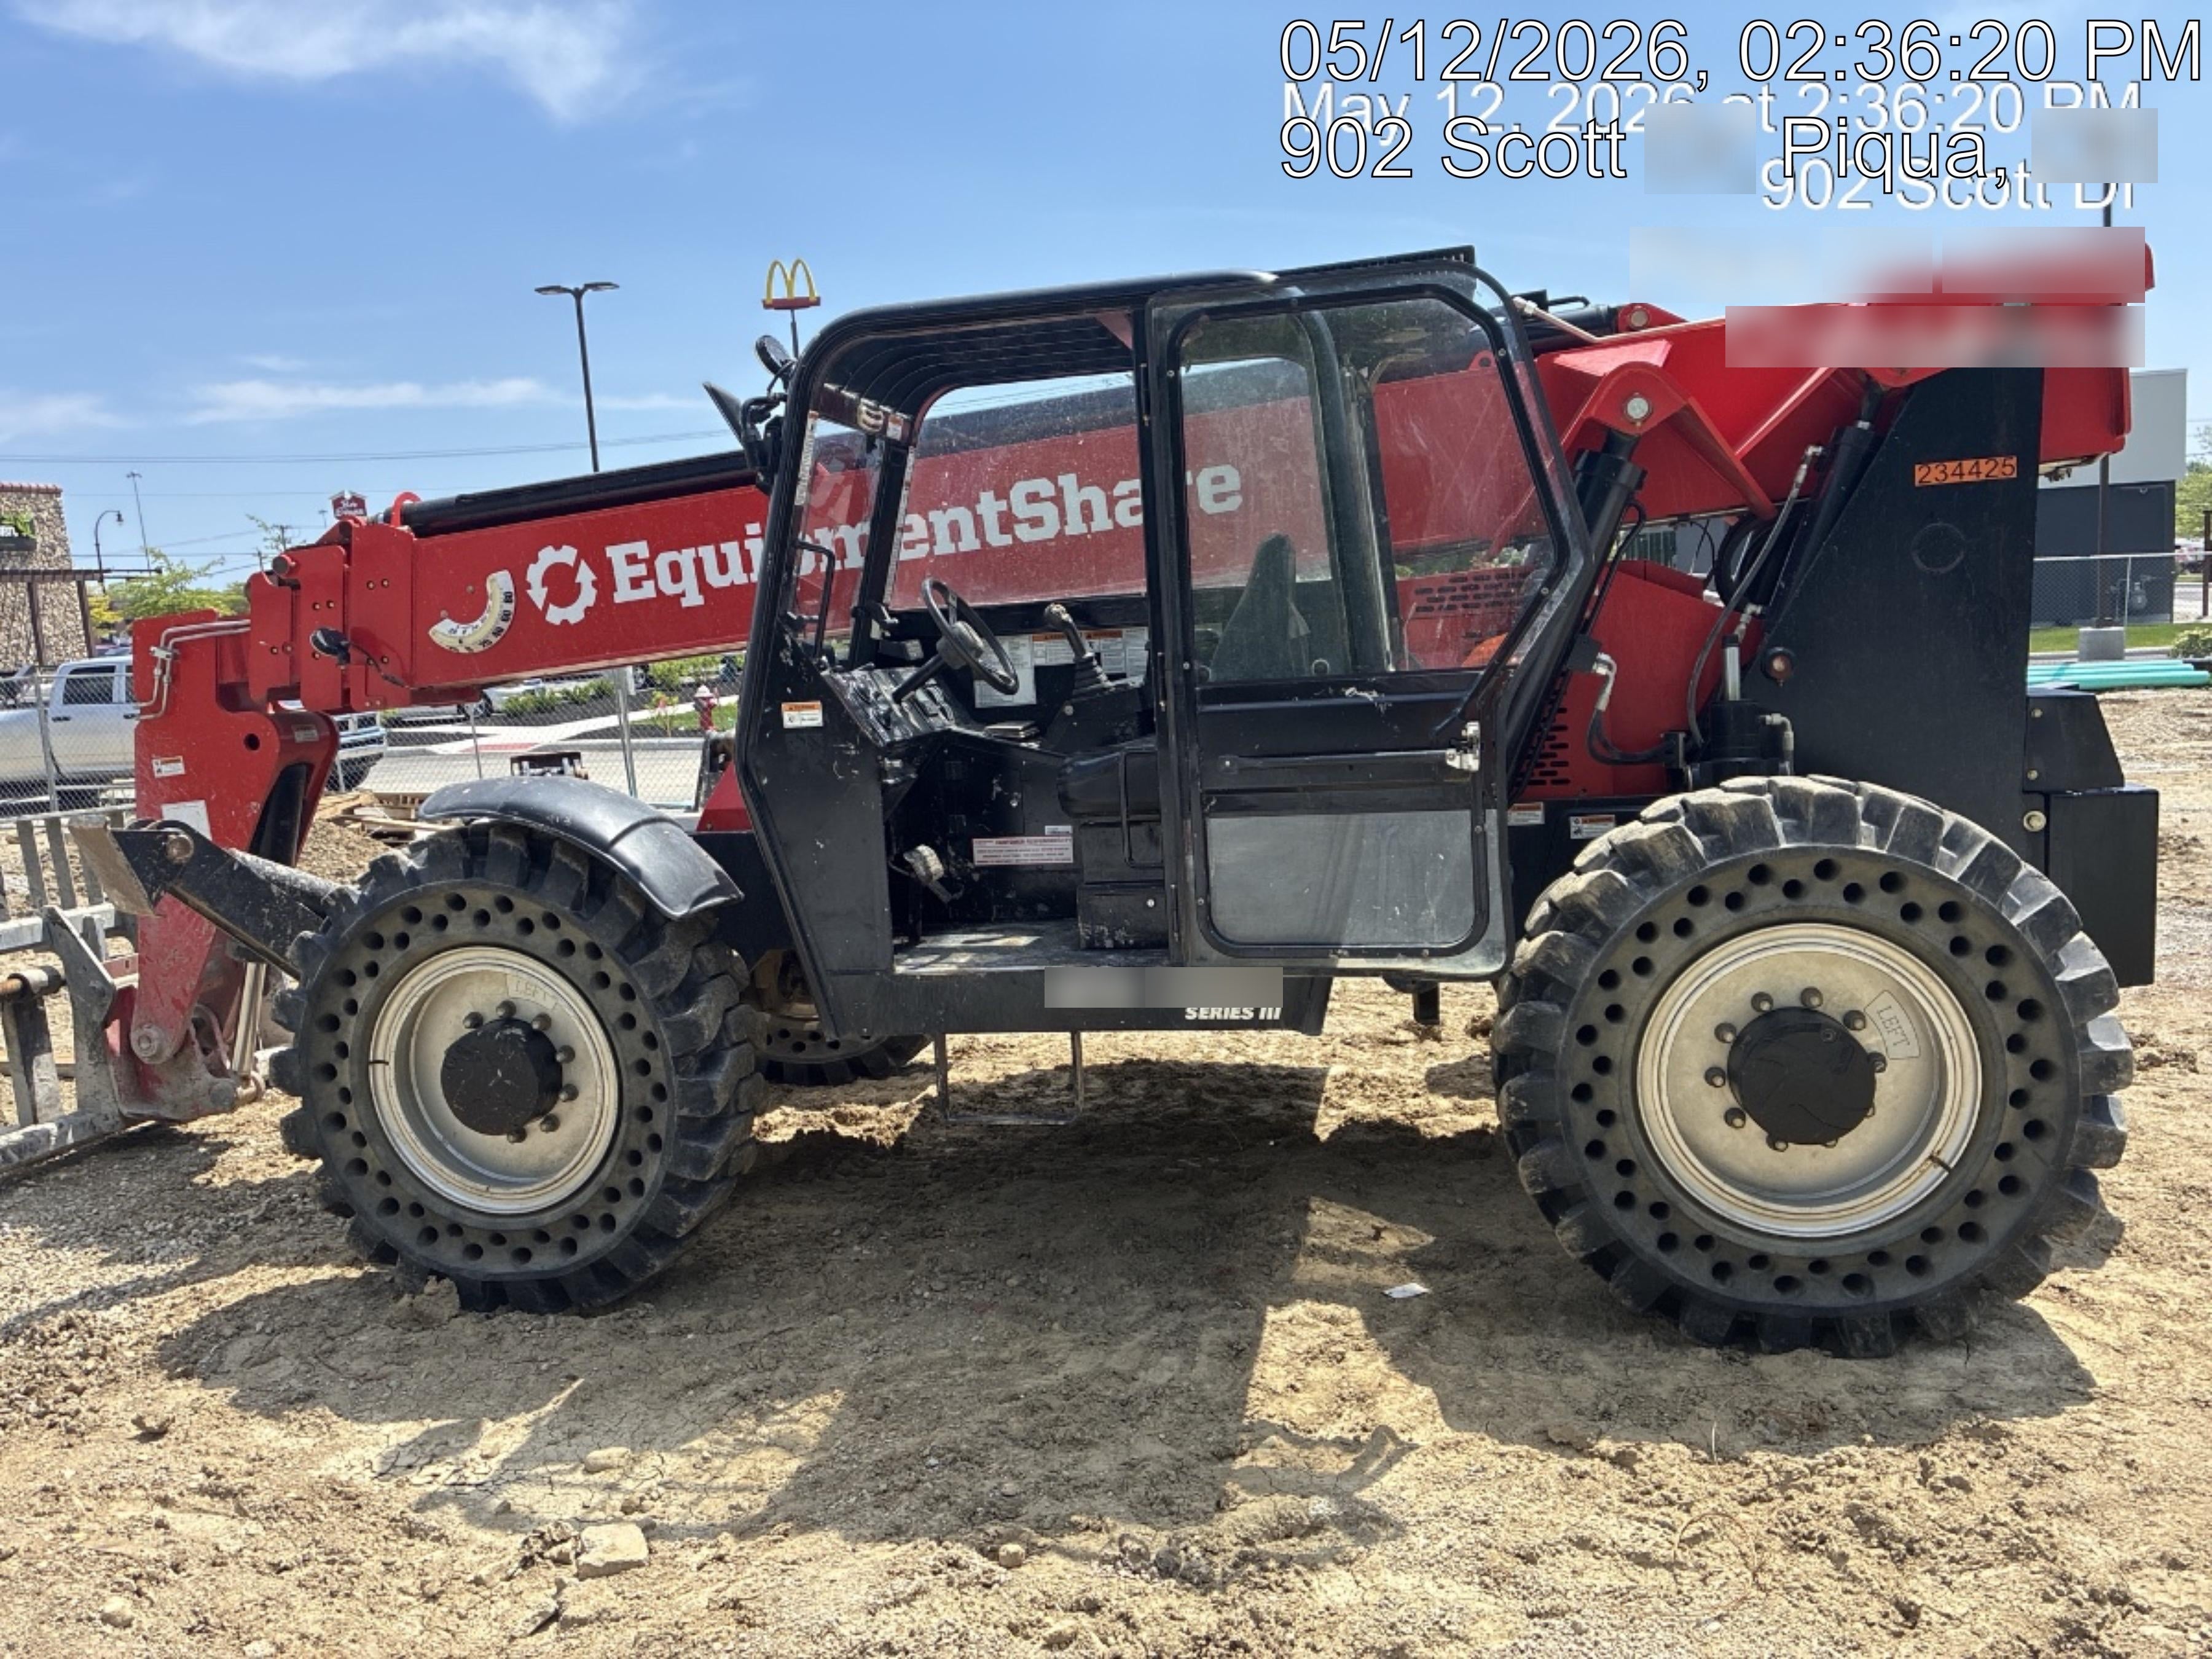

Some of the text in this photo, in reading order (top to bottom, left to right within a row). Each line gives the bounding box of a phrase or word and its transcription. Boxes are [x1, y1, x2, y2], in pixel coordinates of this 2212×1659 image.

[1918, 457, 2016, 484] 234425
[606, 464, 1243, 608] EquimentShae
[1185, 1007, 1255, 1021] SERIES
[1877, 1005, 1911, 1046] LEFT
